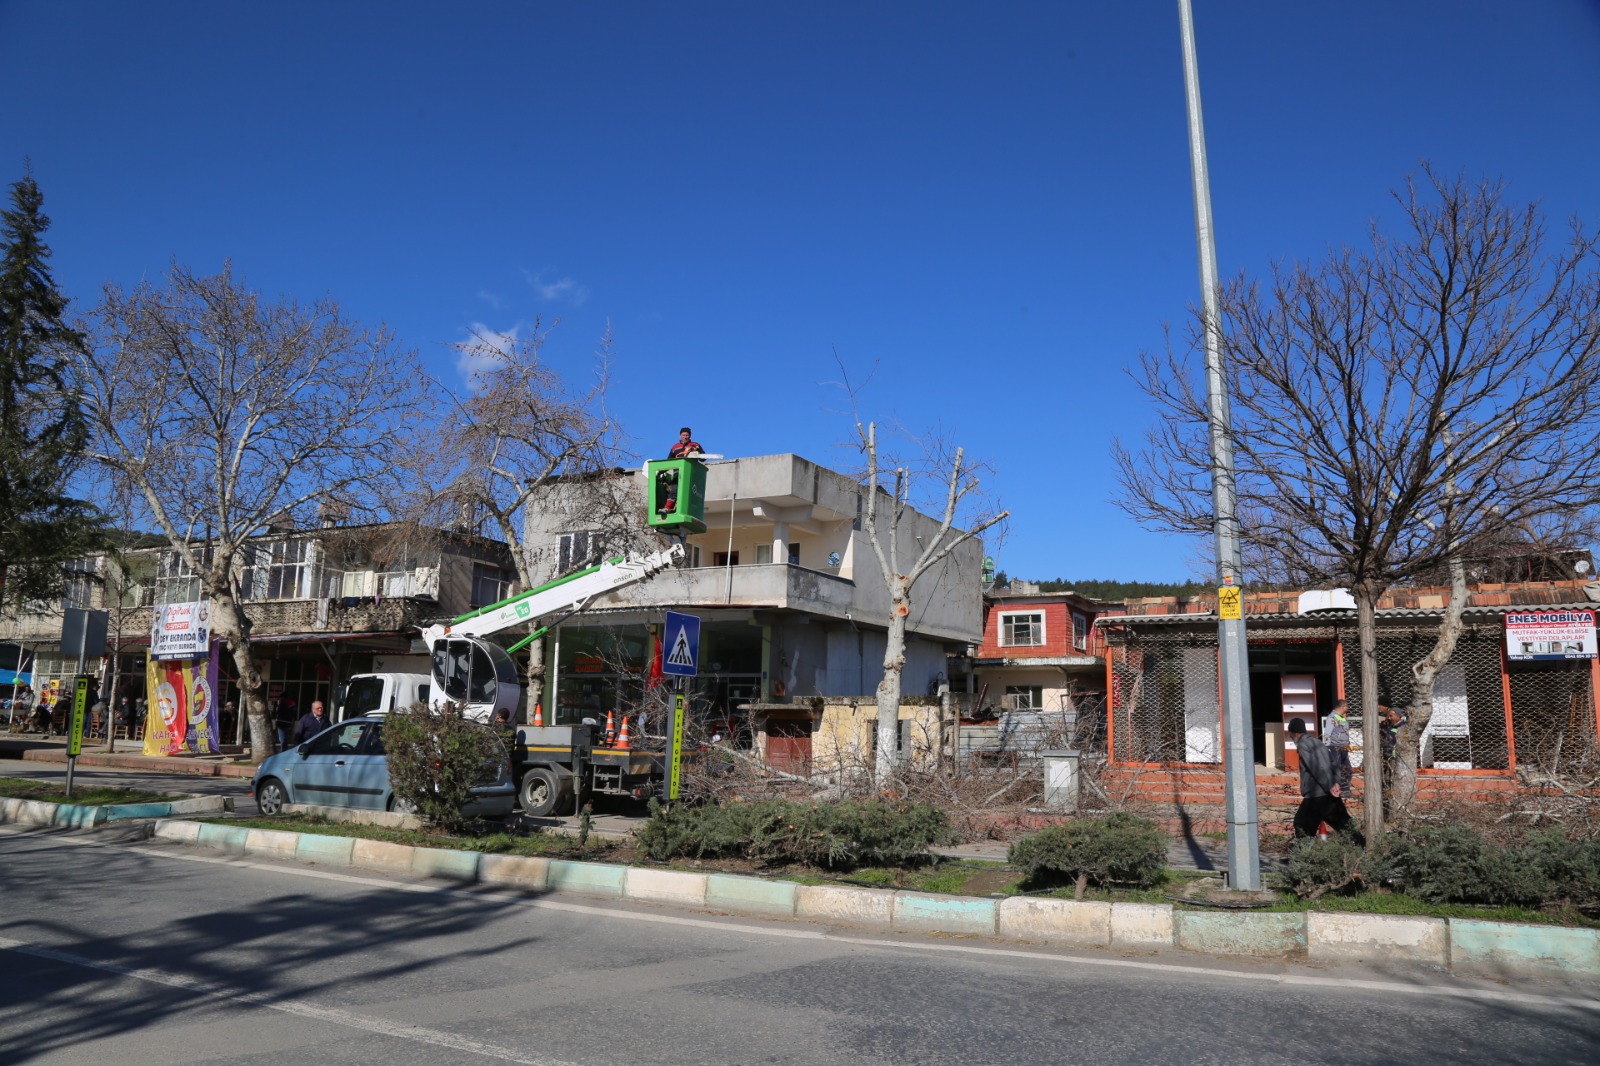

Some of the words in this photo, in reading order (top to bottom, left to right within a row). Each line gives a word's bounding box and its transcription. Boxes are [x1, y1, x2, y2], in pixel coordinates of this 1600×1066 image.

[1507, 614, 1537, 623] ENES
[1540, 611, 1592, 623] MOBİLYA
[170, 632, 197, 642] EKRANDA
